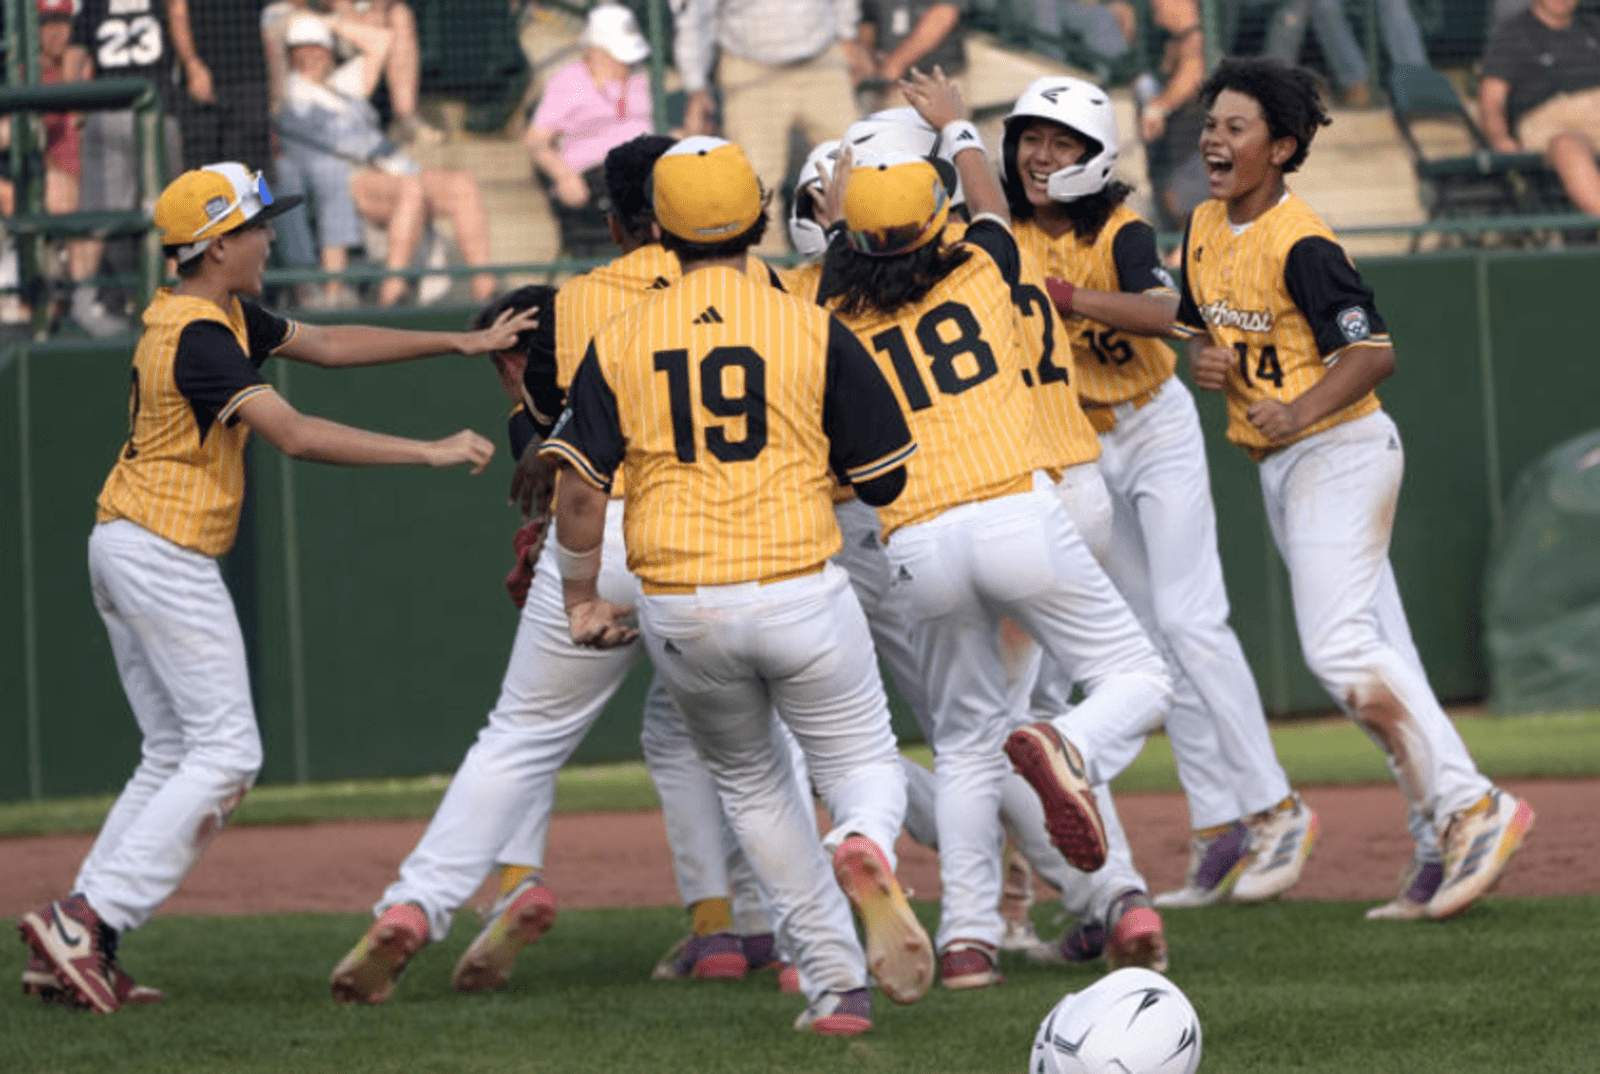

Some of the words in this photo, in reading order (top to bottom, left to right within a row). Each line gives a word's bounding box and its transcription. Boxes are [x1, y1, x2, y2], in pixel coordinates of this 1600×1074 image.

[97, 16, 162, 67] 23
[871, 300, 999, 412] 18
[1081, 328, 1134, 365] 15
[1234, 342, 1284, 387] 14
[653, 346, 767, 463] 19
